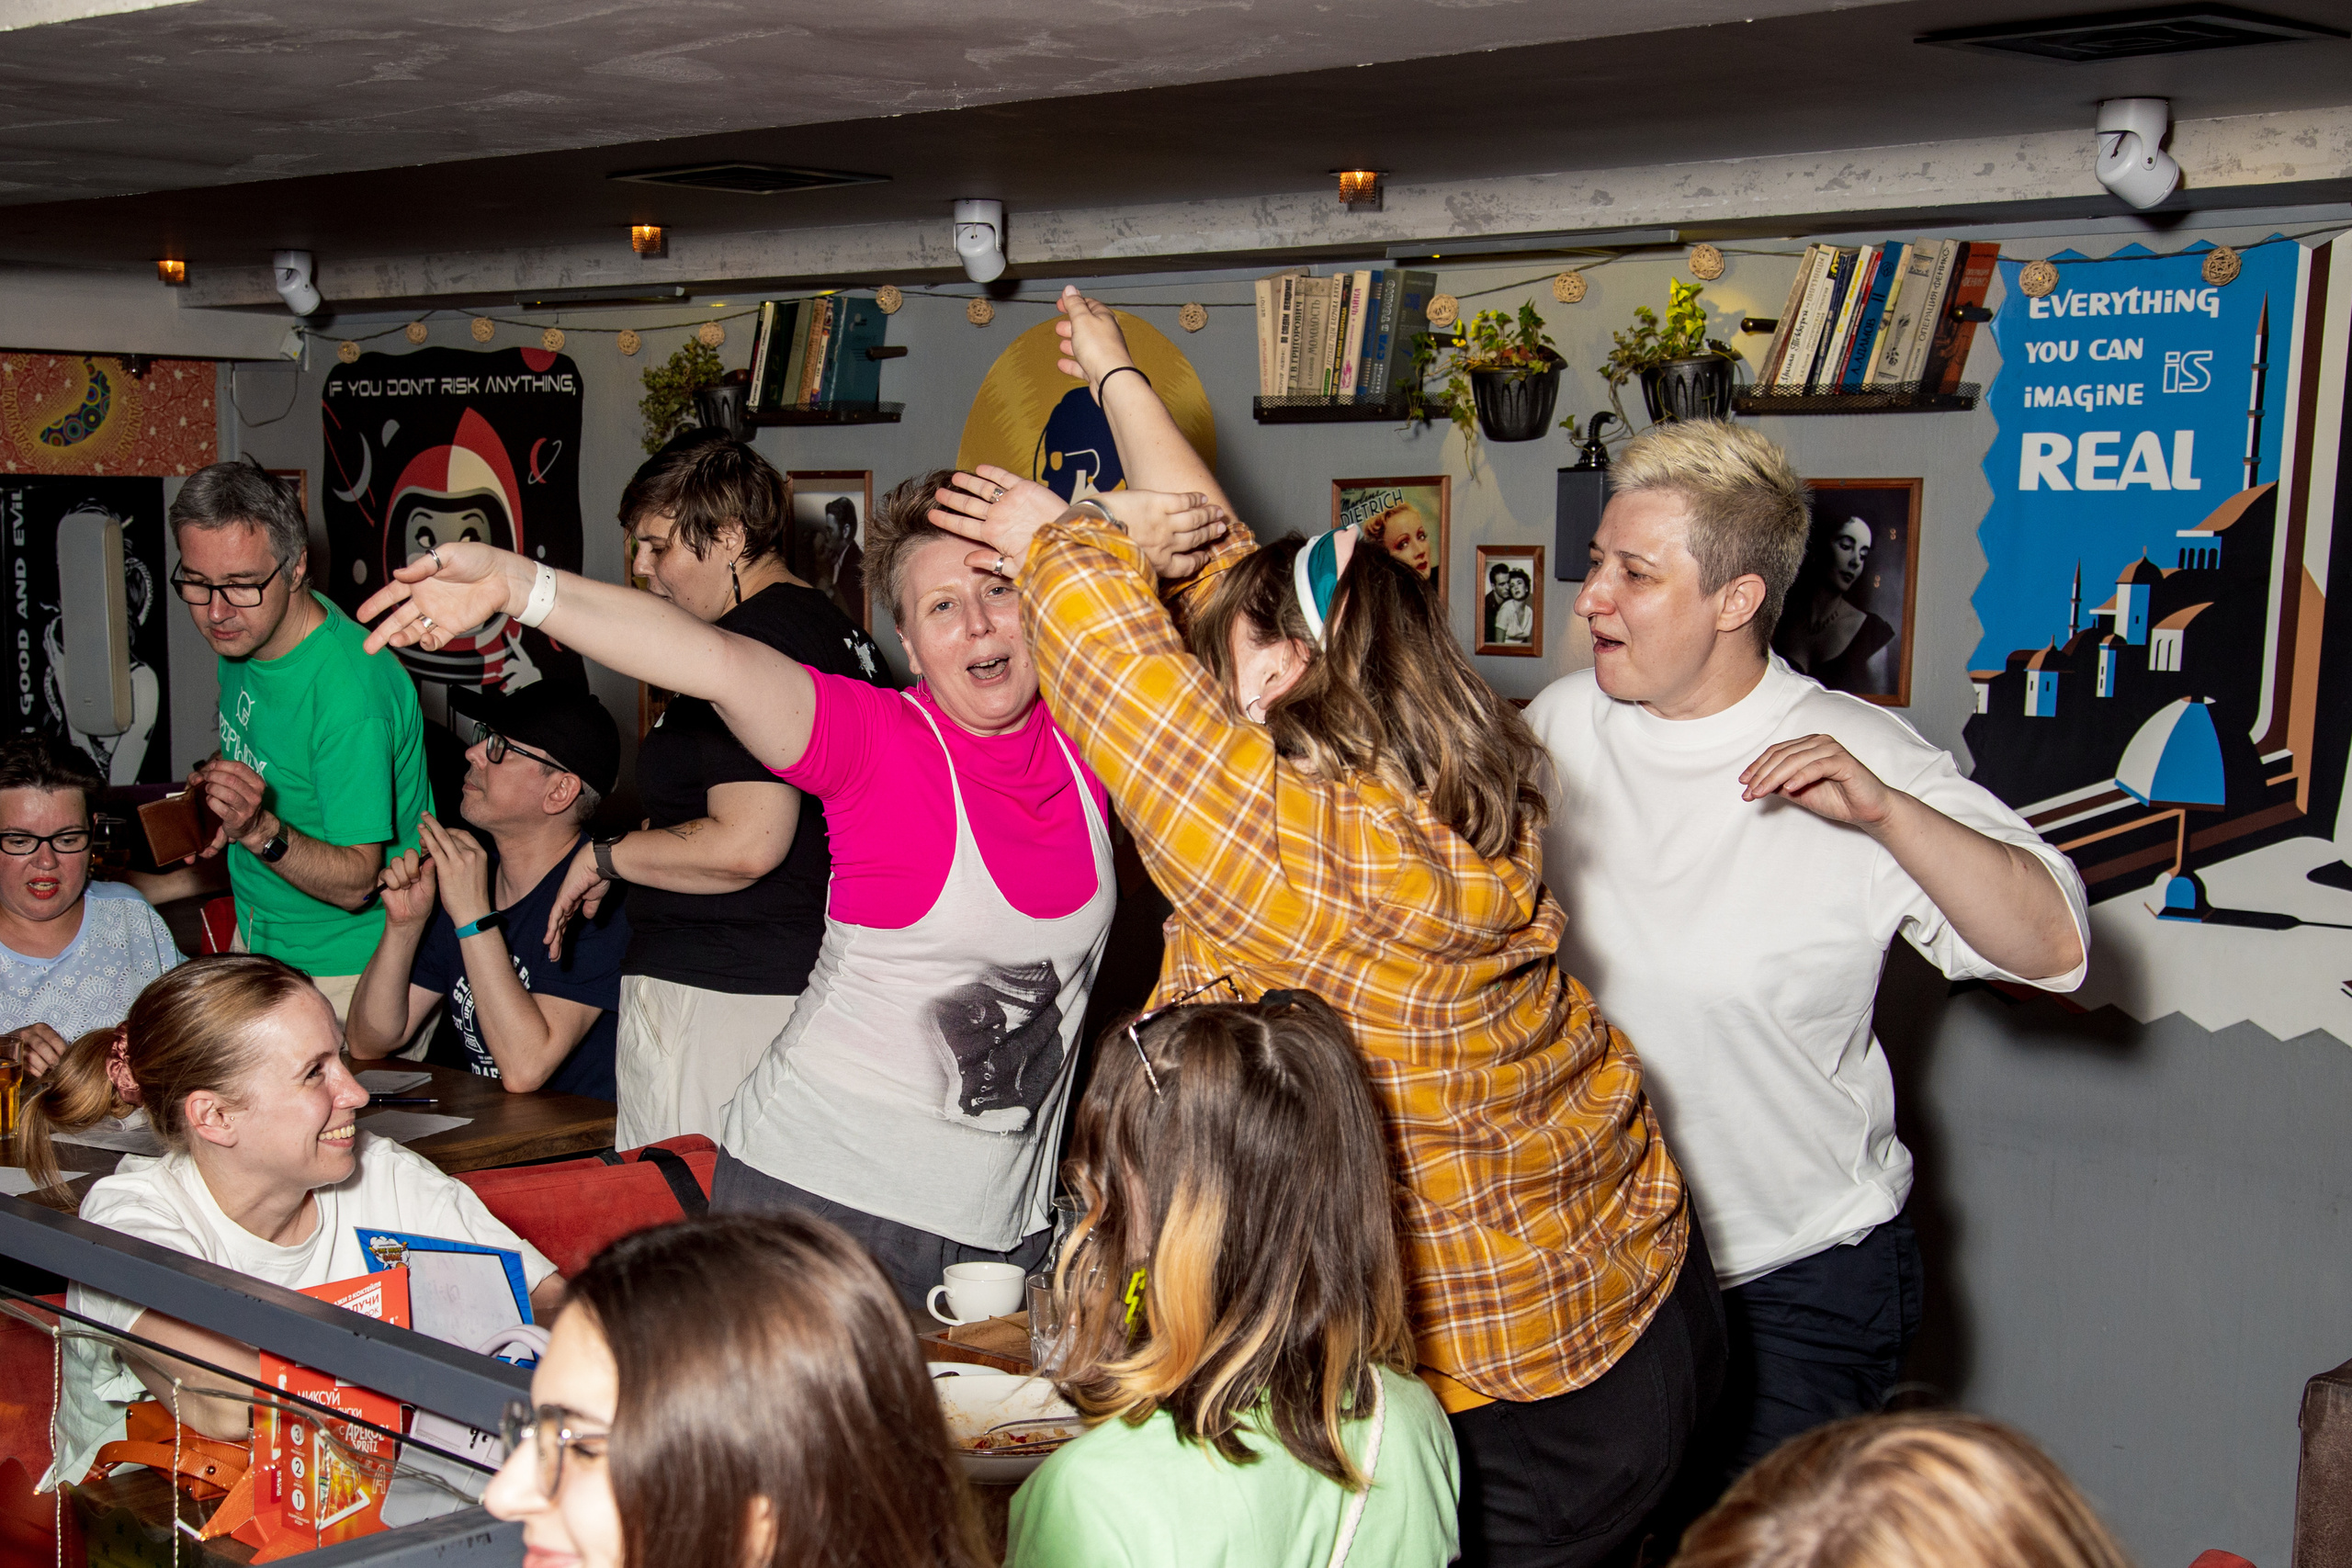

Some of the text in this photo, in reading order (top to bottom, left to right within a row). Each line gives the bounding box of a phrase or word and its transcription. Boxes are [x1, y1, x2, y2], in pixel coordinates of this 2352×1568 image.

[1308, 299, 1320, 355] МОЛОДОСТЬ
[1351, 288, 1361, 315] ЧАЙКА
[1376, 333, 1387, 359] СУД
[1382, 279, 1396, 323] ТОКИО
[1918, 290, 1939, 341] ОПЕРАЦИЯ
[1850, 317, 1875, 375] А.АДАМОВ
[2025, 338, 2143, 364] YOU CAN
[329, 374, 577, 397] IF YOU DON'T RISK ANYTHING,
[2018, 429, 2201, 491] REAL
[1340, 488, 1404, 527] DIETRICH
[15, 558, 28, 619] AND
[17, 628, 34, 715] GOOD
[352, 1280, 382, 1298] КОКТЕЙЛЯ
